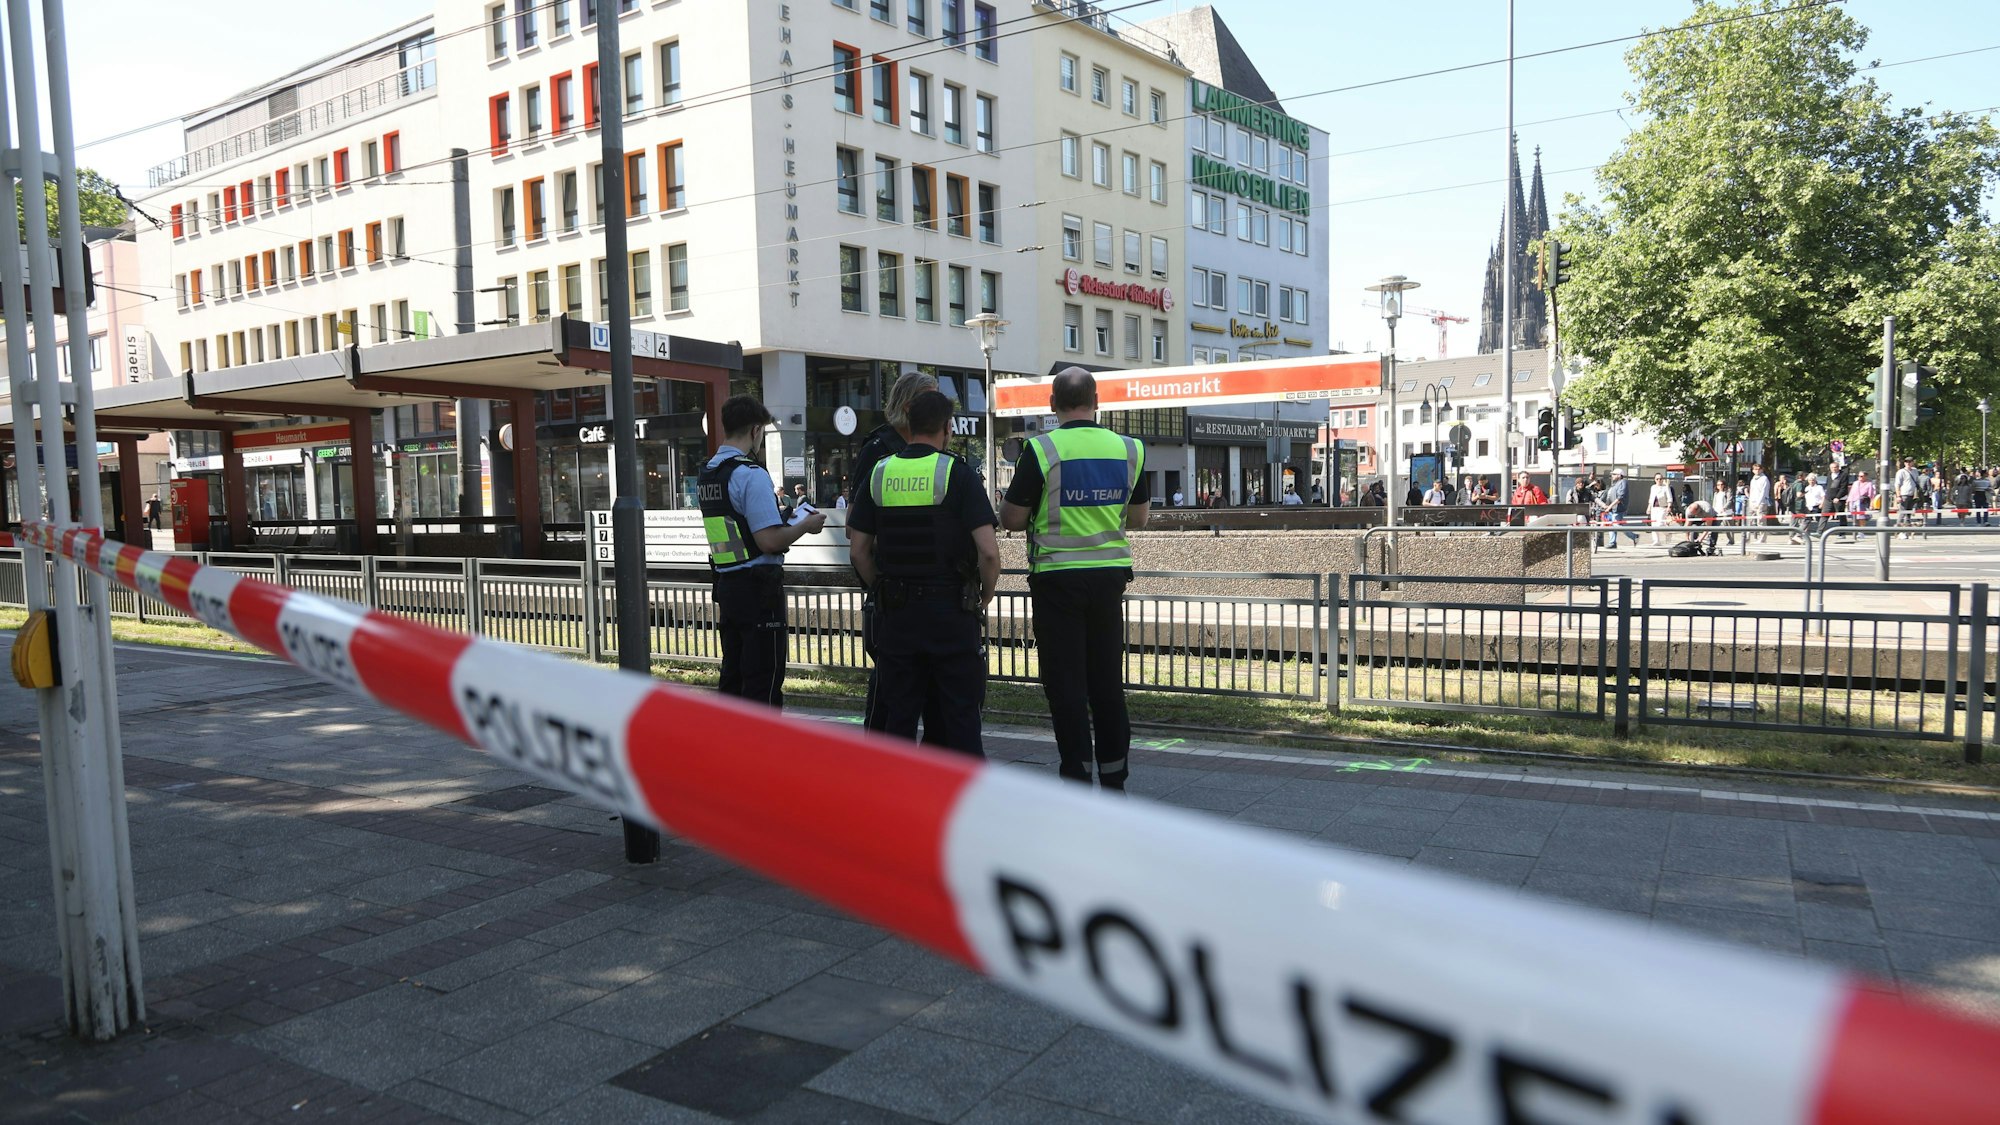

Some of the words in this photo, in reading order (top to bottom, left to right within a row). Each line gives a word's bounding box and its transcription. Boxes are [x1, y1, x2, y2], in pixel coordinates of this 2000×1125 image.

[1192, 79, 1309, 151] LAMMERTING
[1192, 153, 1309, 217] IMMOBILIEN
[658, 342, 667, 357] 4
[1126, 376, 1221, 398] Heumarkt
[275, 431, 307, 444] Heumarkt
[579, 425, 606, 443] Café
[1206, 422, 1258, 436] RESTAURANT
[1266, 426, 1308, 438] HEUMARKT
[886, 476, 930, 492] POLIZEI
[1066, 489, 1089, 501] VU-
[1092, 488, 1123, 500] TEAM
[462, 686, 632, 810] POLIZEI
[993, 873, 1706, 1125] POLIZE
